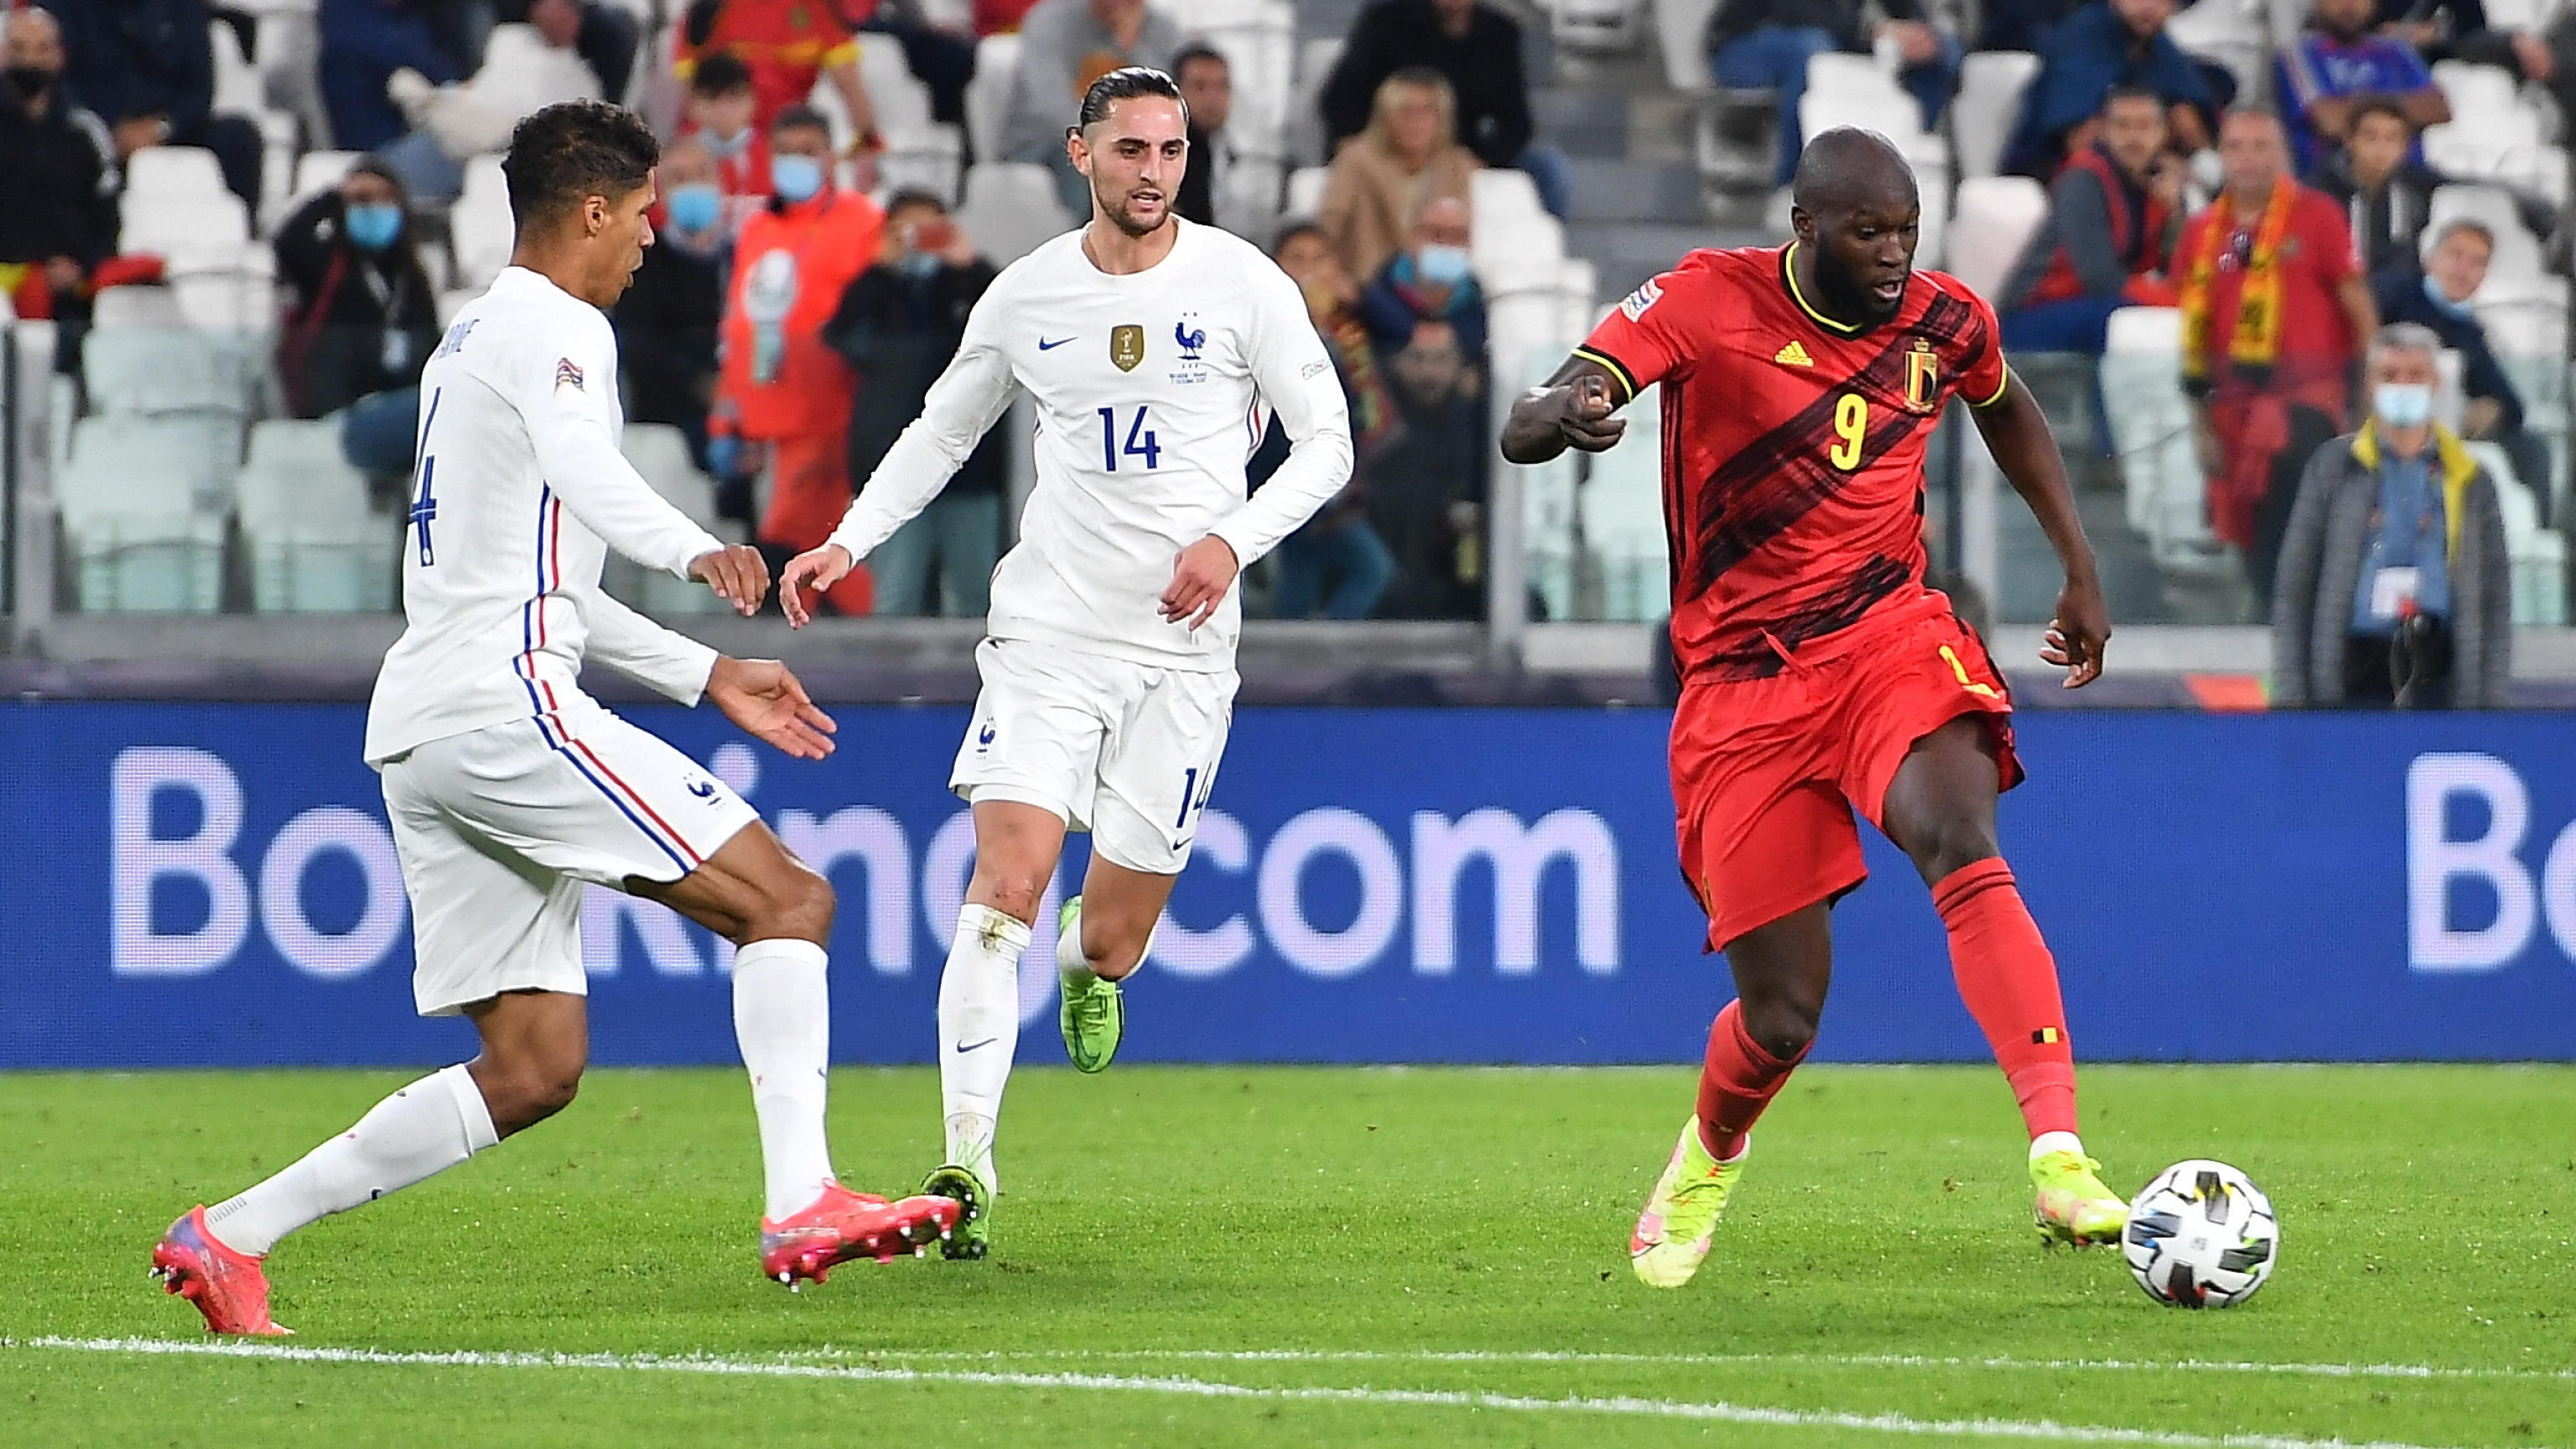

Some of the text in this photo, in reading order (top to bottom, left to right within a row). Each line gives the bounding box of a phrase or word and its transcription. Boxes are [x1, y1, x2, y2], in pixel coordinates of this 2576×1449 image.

[1098, 405, 1161, 471] 14
[1831, 393, 1868, 470] 9
[408, 387, 441, 567] 4
[1176, 761, 1213, 828] 14
[2406, 752, 2576, 973] B
